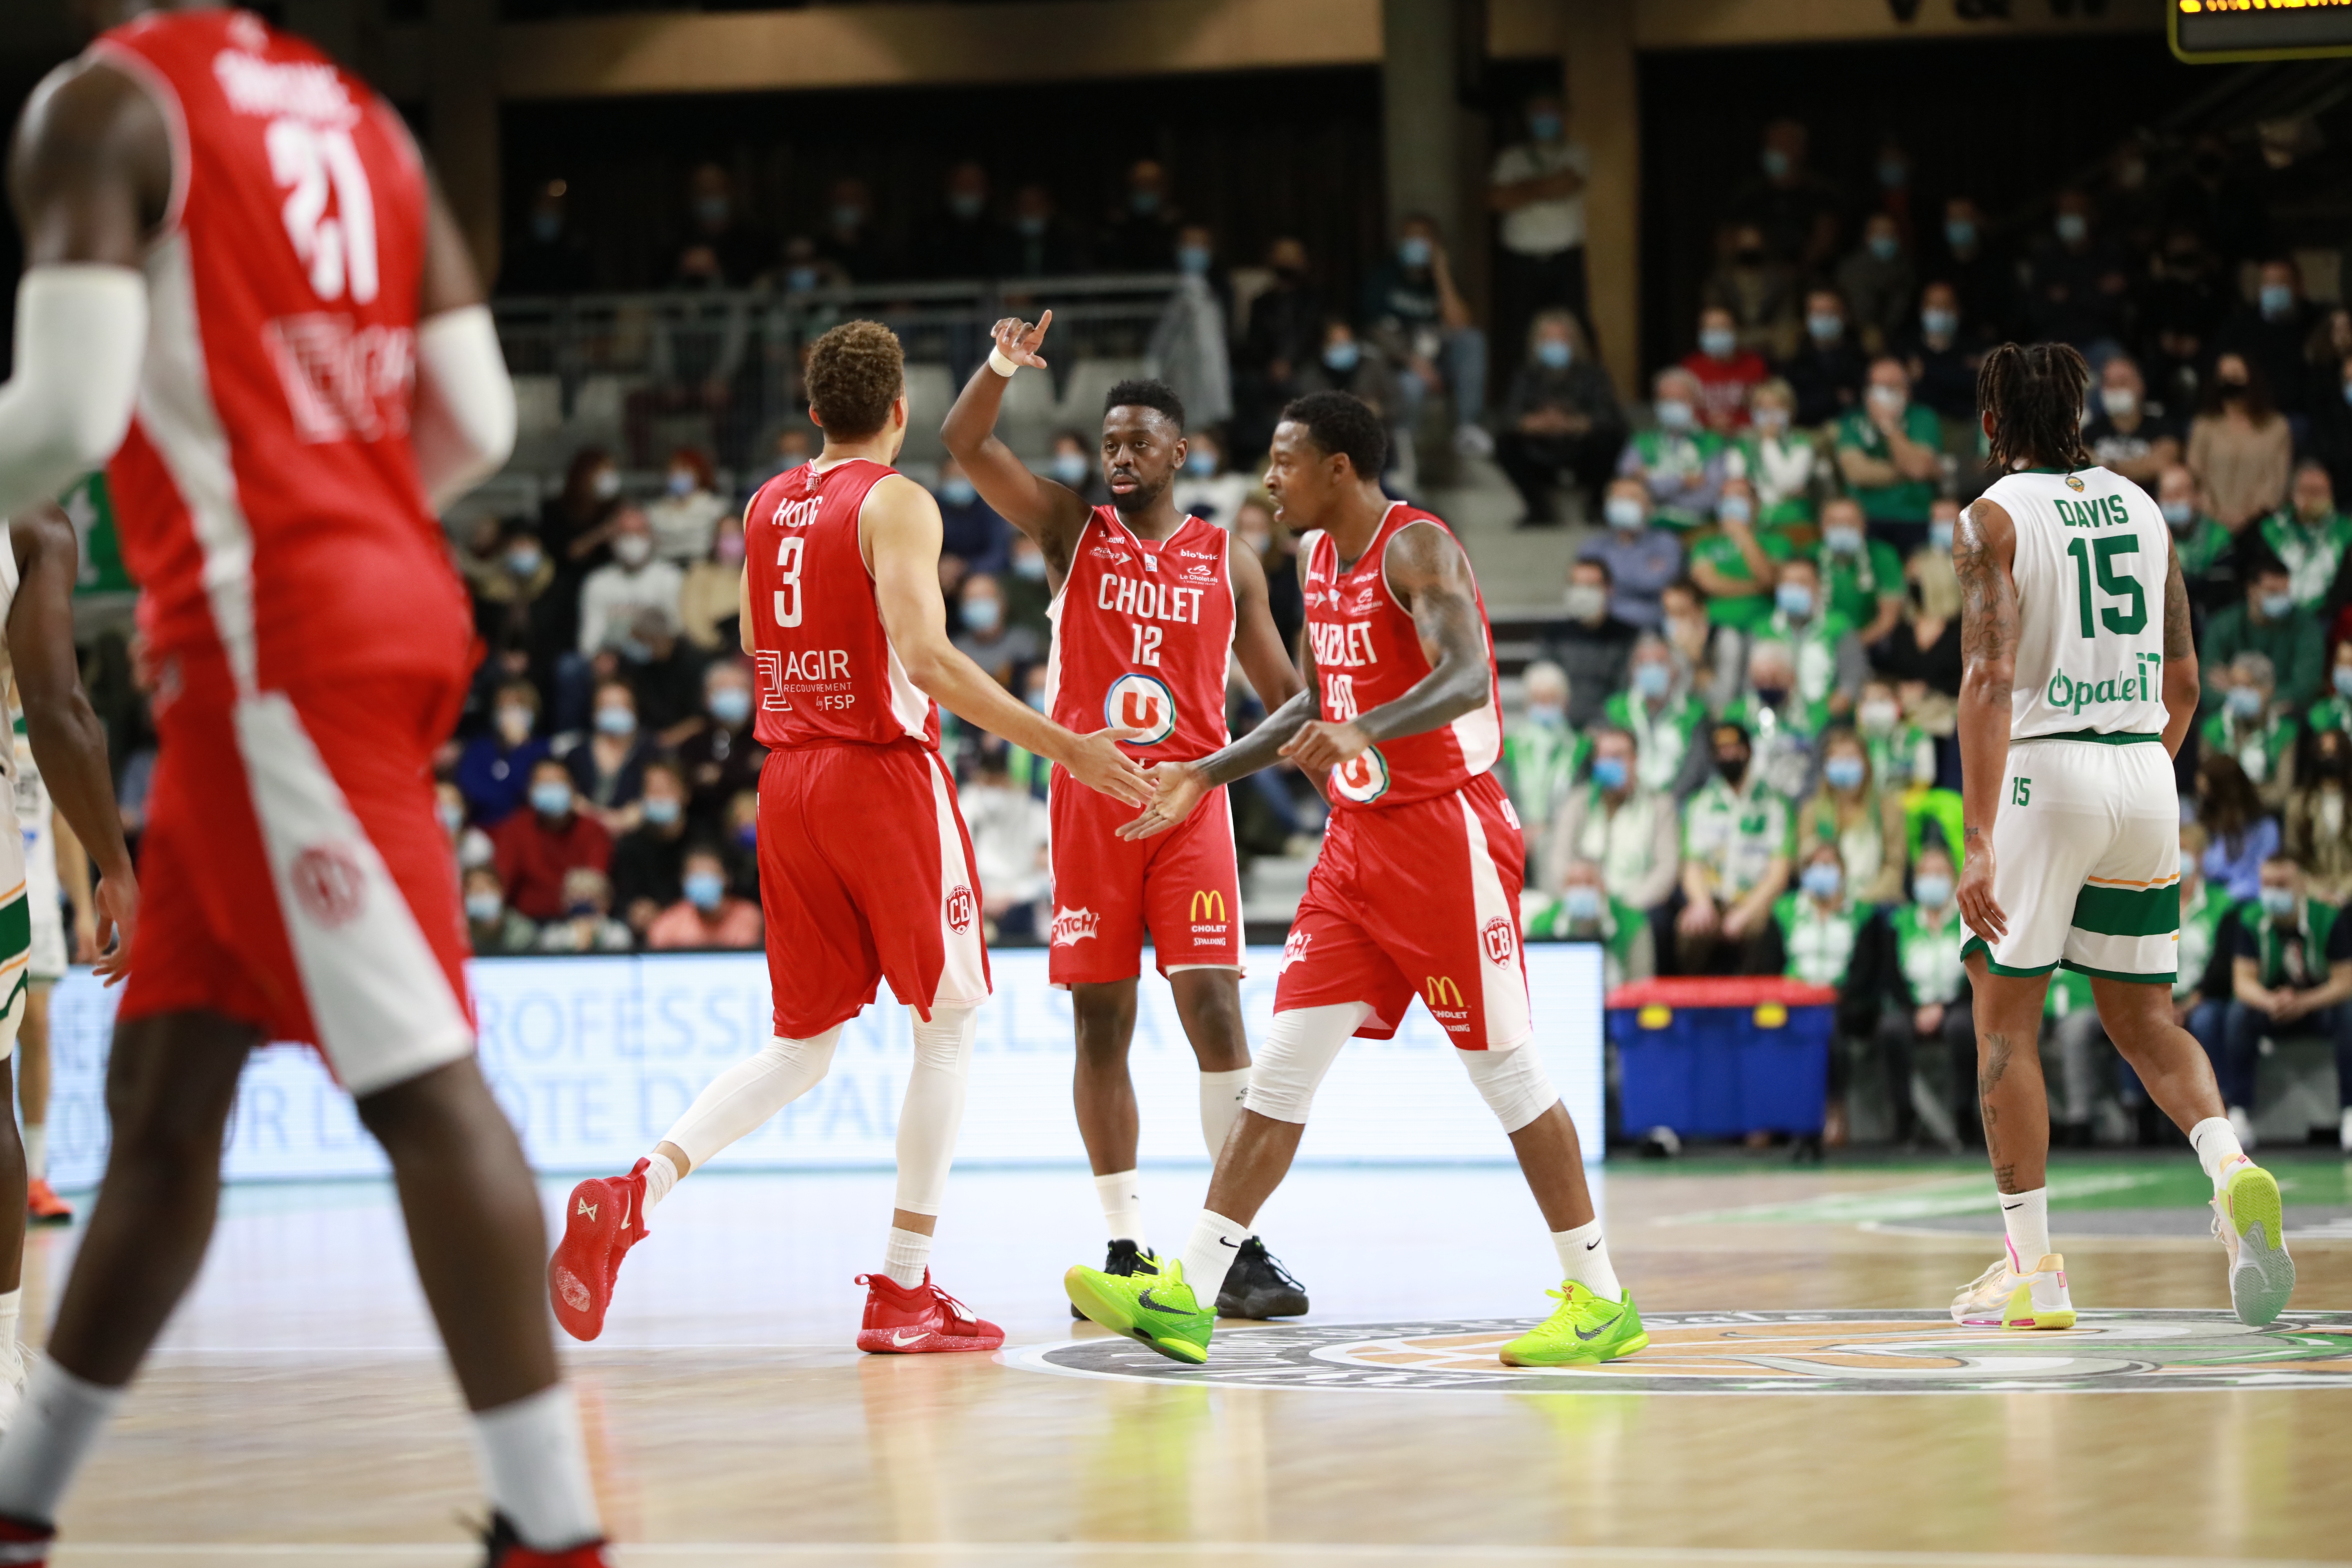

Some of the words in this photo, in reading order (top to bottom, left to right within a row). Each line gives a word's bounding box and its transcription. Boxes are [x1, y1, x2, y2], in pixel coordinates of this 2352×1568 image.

[2054, 494, 2129, 528] DAVIS
[774, 536, 804, 628] 3
[1098, 572, 1204, 624] CHOLET
[2067, 534, 2147, 638] 15
[1132, 623, 1163, 667] 12
[784, 650, 851, 681] AGIR
[784, 682, 852, 693] RECOUVREMENT
[816, 696, 823, 711] by
[824, 694, 855, 710] FSP
[1327, 673, 1358, 721] 40
[2012, 777, 2031, 807] 15
[950, 895, 970, 925] CB
[1194, 937, 1226, 946] SPALDING
[1486, 926, 1511, 960] CB
